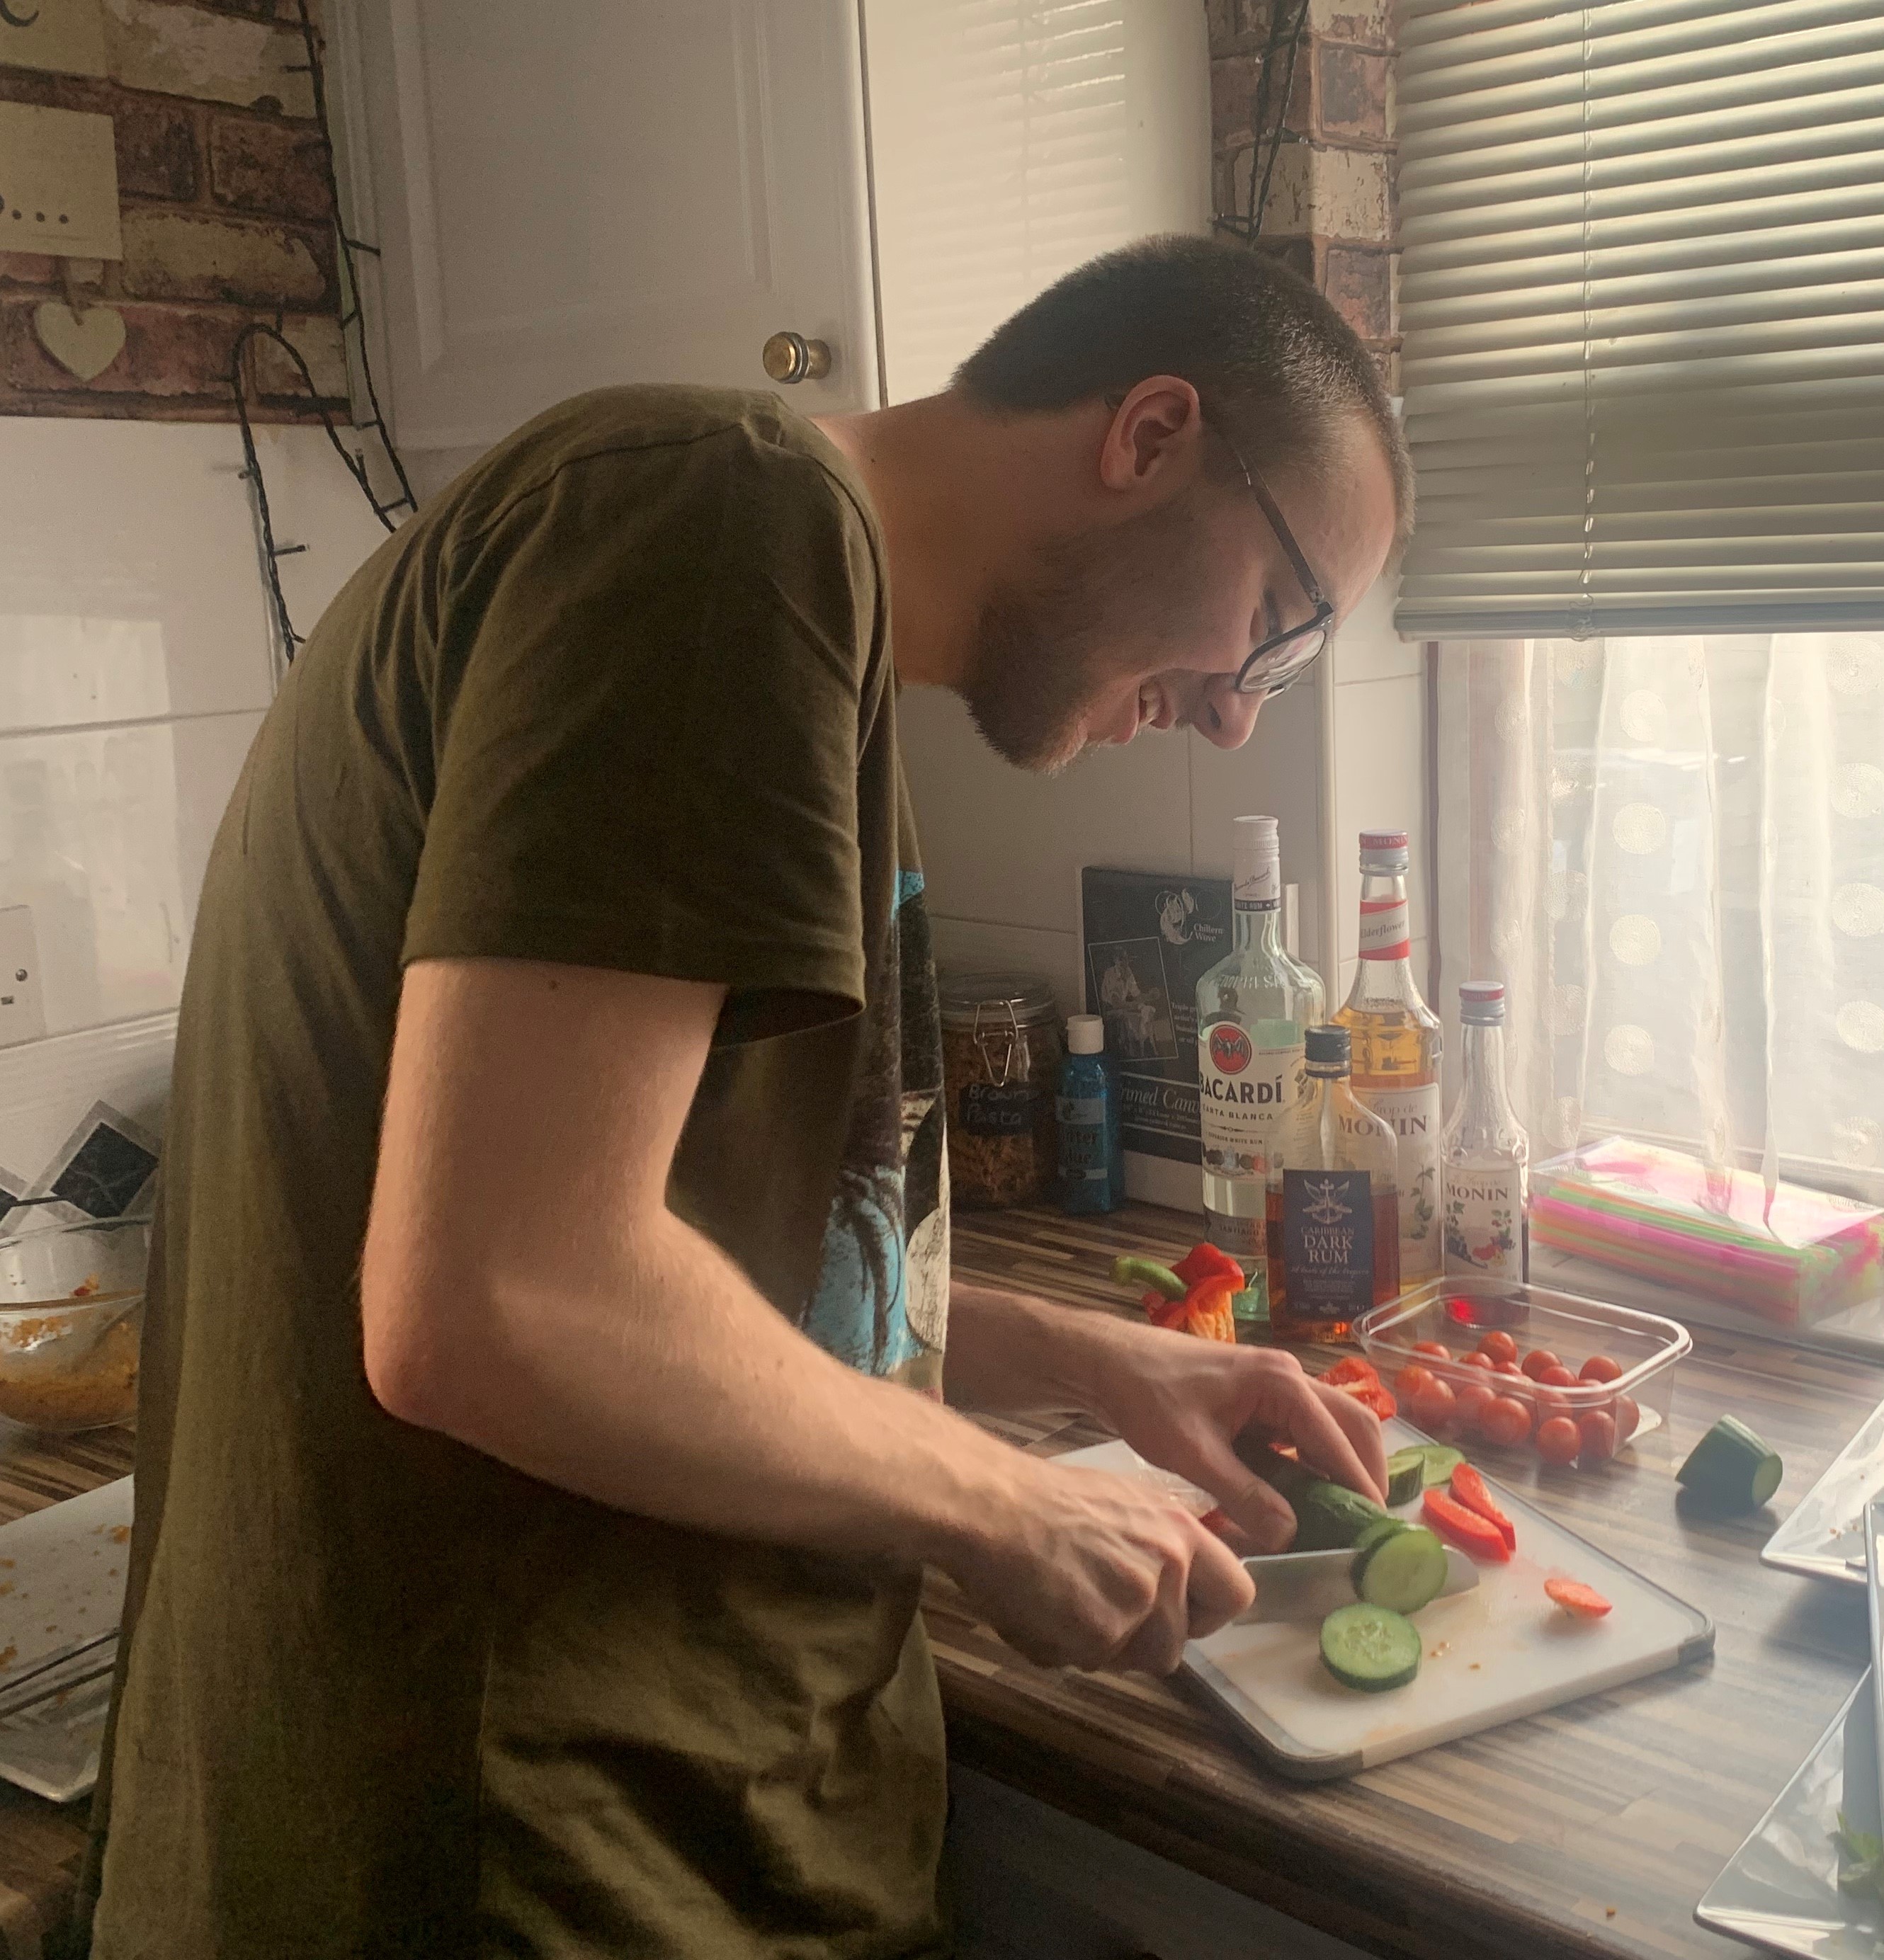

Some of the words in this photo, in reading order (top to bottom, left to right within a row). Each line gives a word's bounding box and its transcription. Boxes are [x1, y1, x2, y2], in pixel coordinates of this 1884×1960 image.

[1193, 923, 1224, 935] Chiltern
[1360, 920, 1405, 938] Elderflower
[1199, 1071, 1283, 1104] BACARDÍ
[1121, 1086, 1159, 1106] rimed
[1163, 1088, 1201, 1114] Canv
[1228, 1111, 1273, 1121] BLANCA
[1338, 1114, 1427, 1136] MONIN
[1446, 1182, 1509, 1201] MONIN
[1300, 1226, 1354, 1236] CARIBBEAN
[1304, 1235, 1353, 1250] DARK
[1309, 1249, 1349, 1264] RUM
